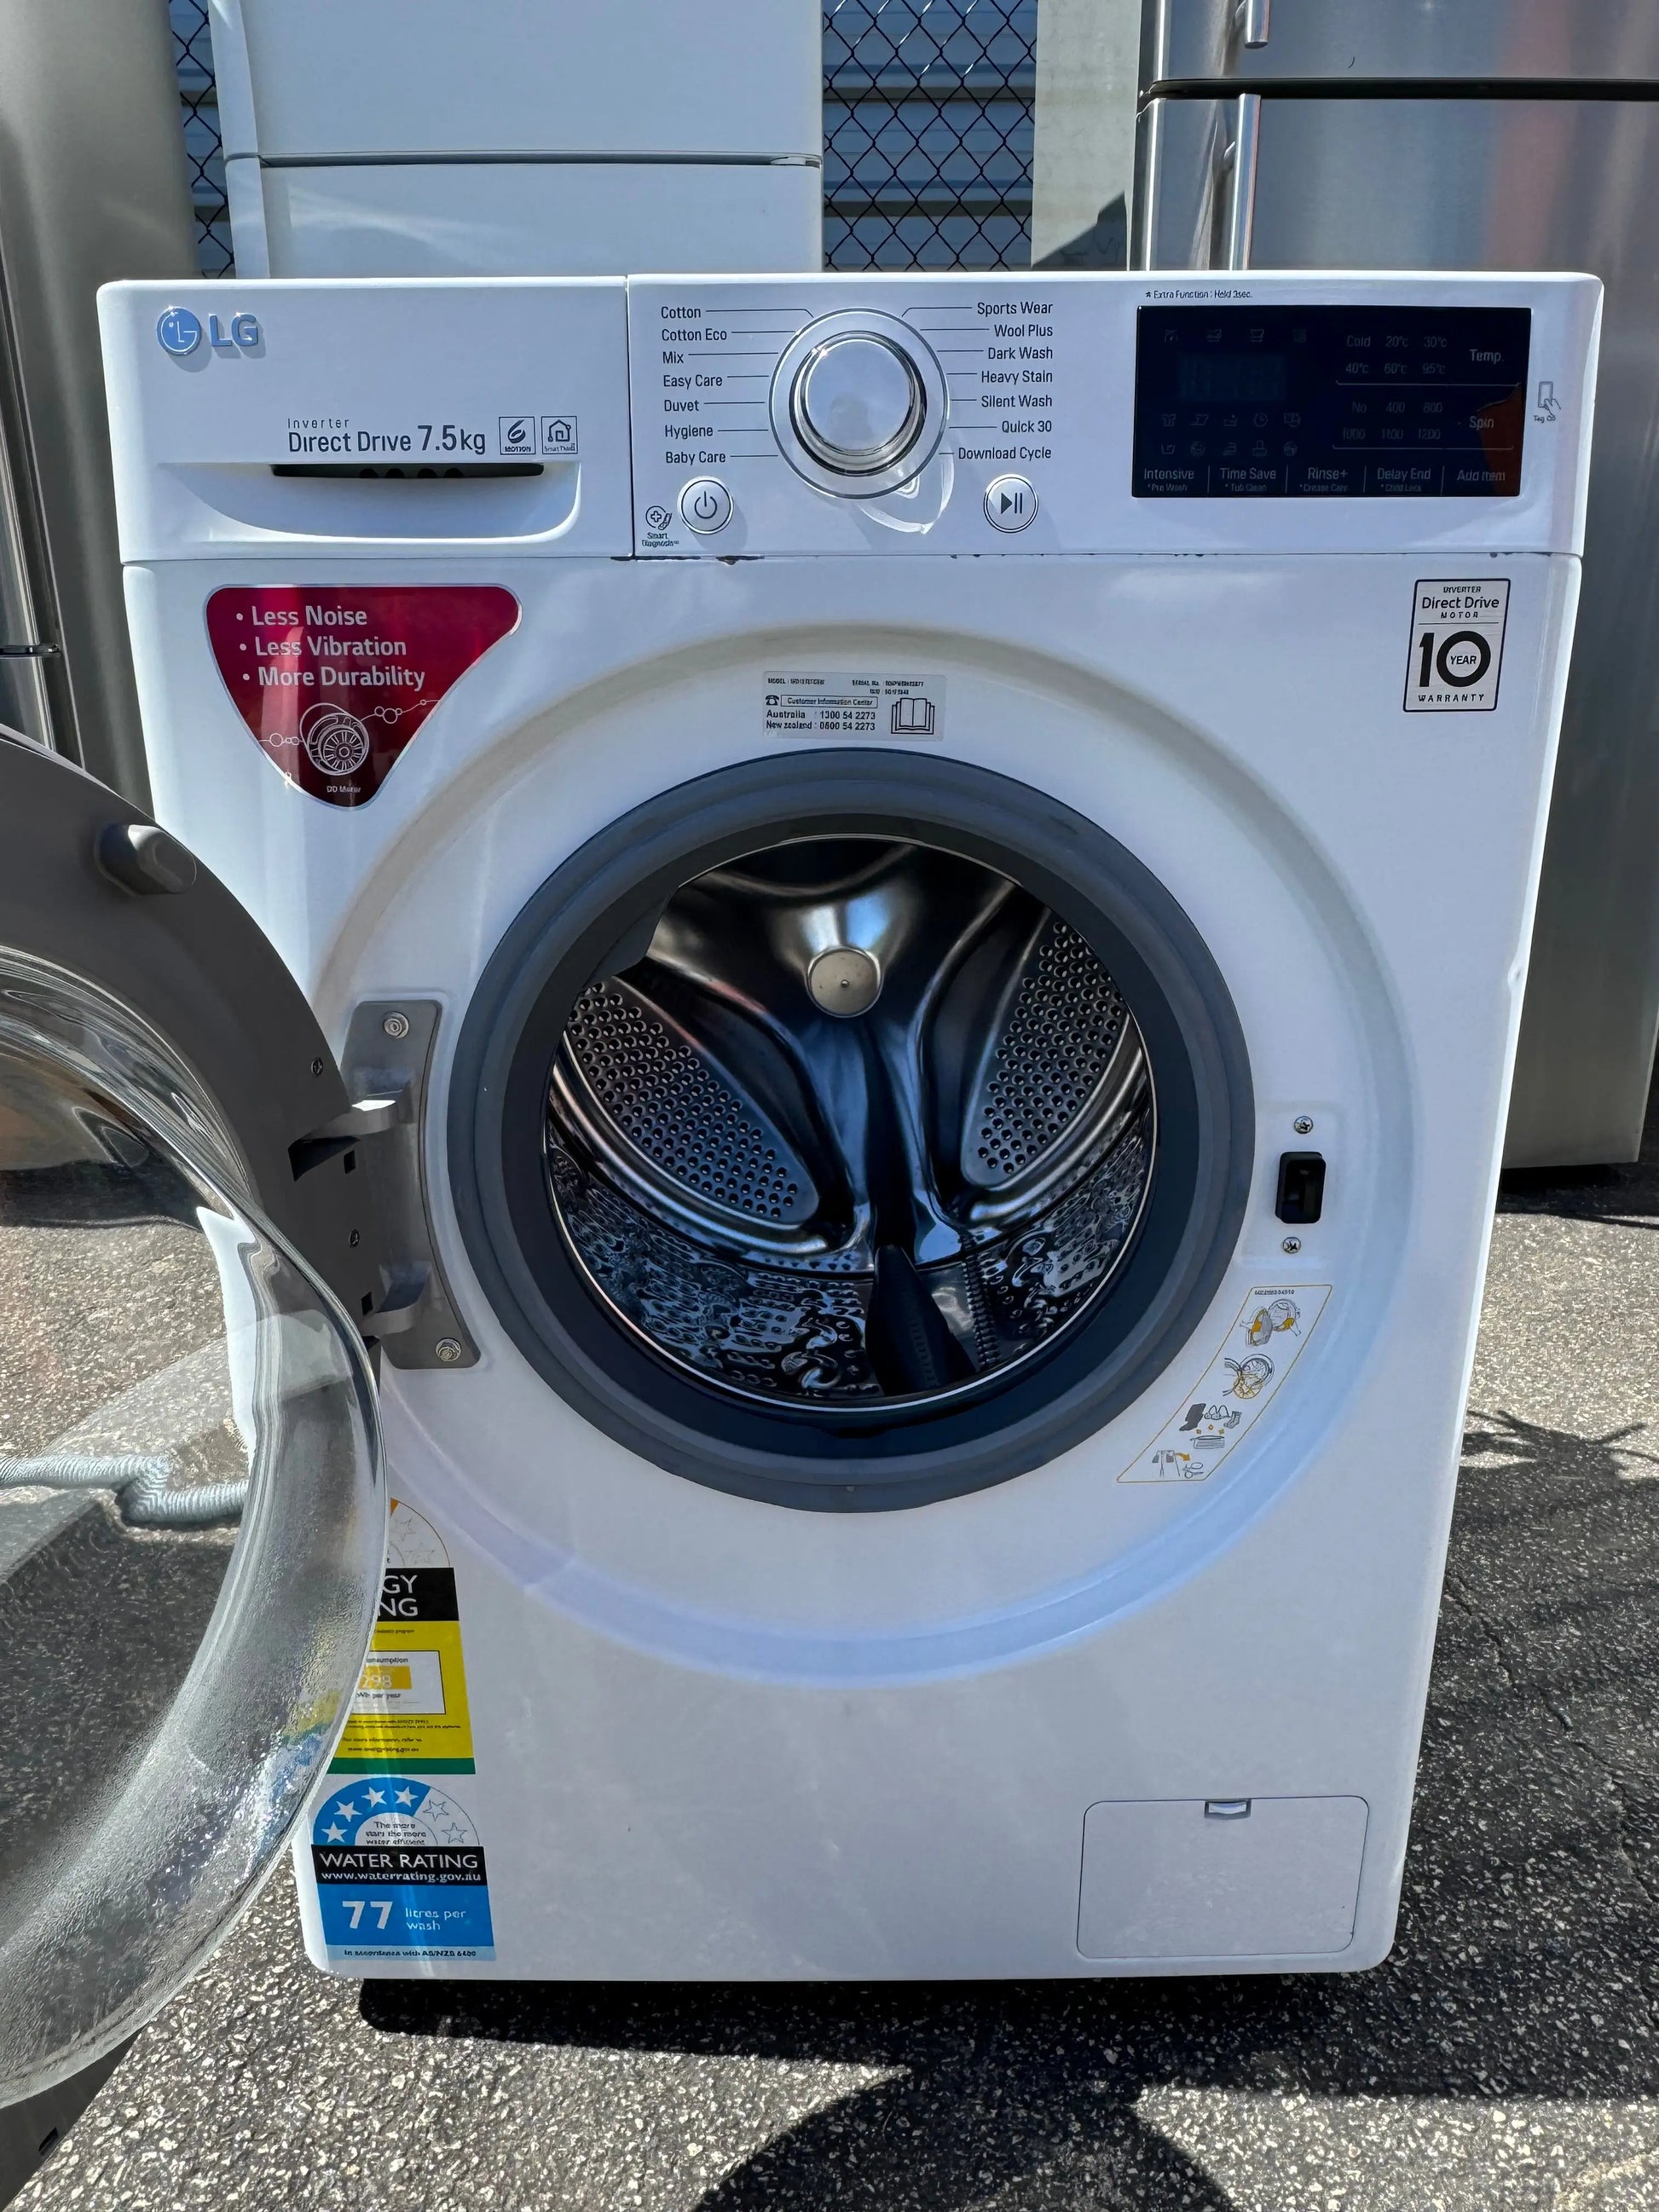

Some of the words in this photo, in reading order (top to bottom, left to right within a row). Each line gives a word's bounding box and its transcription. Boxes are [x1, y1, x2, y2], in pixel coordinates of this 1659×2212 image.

[661, 305, 701, 320] Cotton
[977, 302, 1018, 316] Sports
[1020, 302, 1053, 315] Wear
[210, 313, 258, 347] LG
[662, 329, 697, 341] Cotton
[702, 328, 727, 341] Eco
[994, 325, 1024, 337] Wool
[1028, 325, 1053, 337] Plus
[1346, 335, 1371, 348] Cold
[662, 350, 684, 364] Mix
[987, 347, 1015, 360] Dark
[1019, 347, 1053, 359] Wash
[1470, 349, 1504, 365] Temp.
[663, 375, 691, 390] Easy
[696, 374, 723, 387] Care
[981, 371, 1018, 385] Heavy
[1022, 370, 1052, 383] Stain
[664, 399, 699, 412] Duvet
[981, 396, 1015, 407] Silent
[1019, 395, 1052, 407] Wash
[1352, 402, 1367, 413] No
[1385, 402, 1405, 413] 400
[287, 418, 350, 429] Inverter
[1002, 420, 1032, 433] Quick
[1038, 420, 1052, 432] 30
[1469, 416, 1494, 430] Spin
[665, 424, 713, 438] Hygiene
[289, 431, 351, 453] Direct
[358, 431, 411, 452] Drive
[418, 425, 486, 454] 7.5kg
[666, 451, 696, 465] Baby
[698, 450, 725, 463] Care
[958, 447, 1016, 459] Download
[1020, 447, 1051, 460] Cycle
[1144, 467, 1194, 480] Intensive
[1219, 467, 1246, 479] Time
[1249, 467, 1276, 480] Save
[1308, 468, 1347, 479] Rinse+
[1378, 467, 1407, 482] Delay
[1410, 468, 1431, 480] End
[1457, 470, 1479, 481] Add
[1422, 597, 1460, 609] Direct
[1465, 596, 1499, 608] Drive
[251, 606, 298, 626] Less
[305, 605, 367, 626] Noise
[256, 636, 301, 656] Less
[308, 636, 406, 656] Vibration
[1419, 631, 1491, 687] 10
[1451, 656, 1477, 665] YEAR
[258, 667, 314, 685] More
[321, 666, 425, 692] Durability
[766, 710, 805, 719] Australia
[766, 720, 782, 729] New
[320, 1853, 393, 1868] WATER
[400, 1855, 477, 1868] RATING
[321, 1872, 481, 1884] www.waterrating.gov.au
[342, 1901, 393, 1929] 77
[406, 1908, 437, 1918] litres
[444, 1910, 465, 1922] per
[407, 1920, 440, 1930] wash
